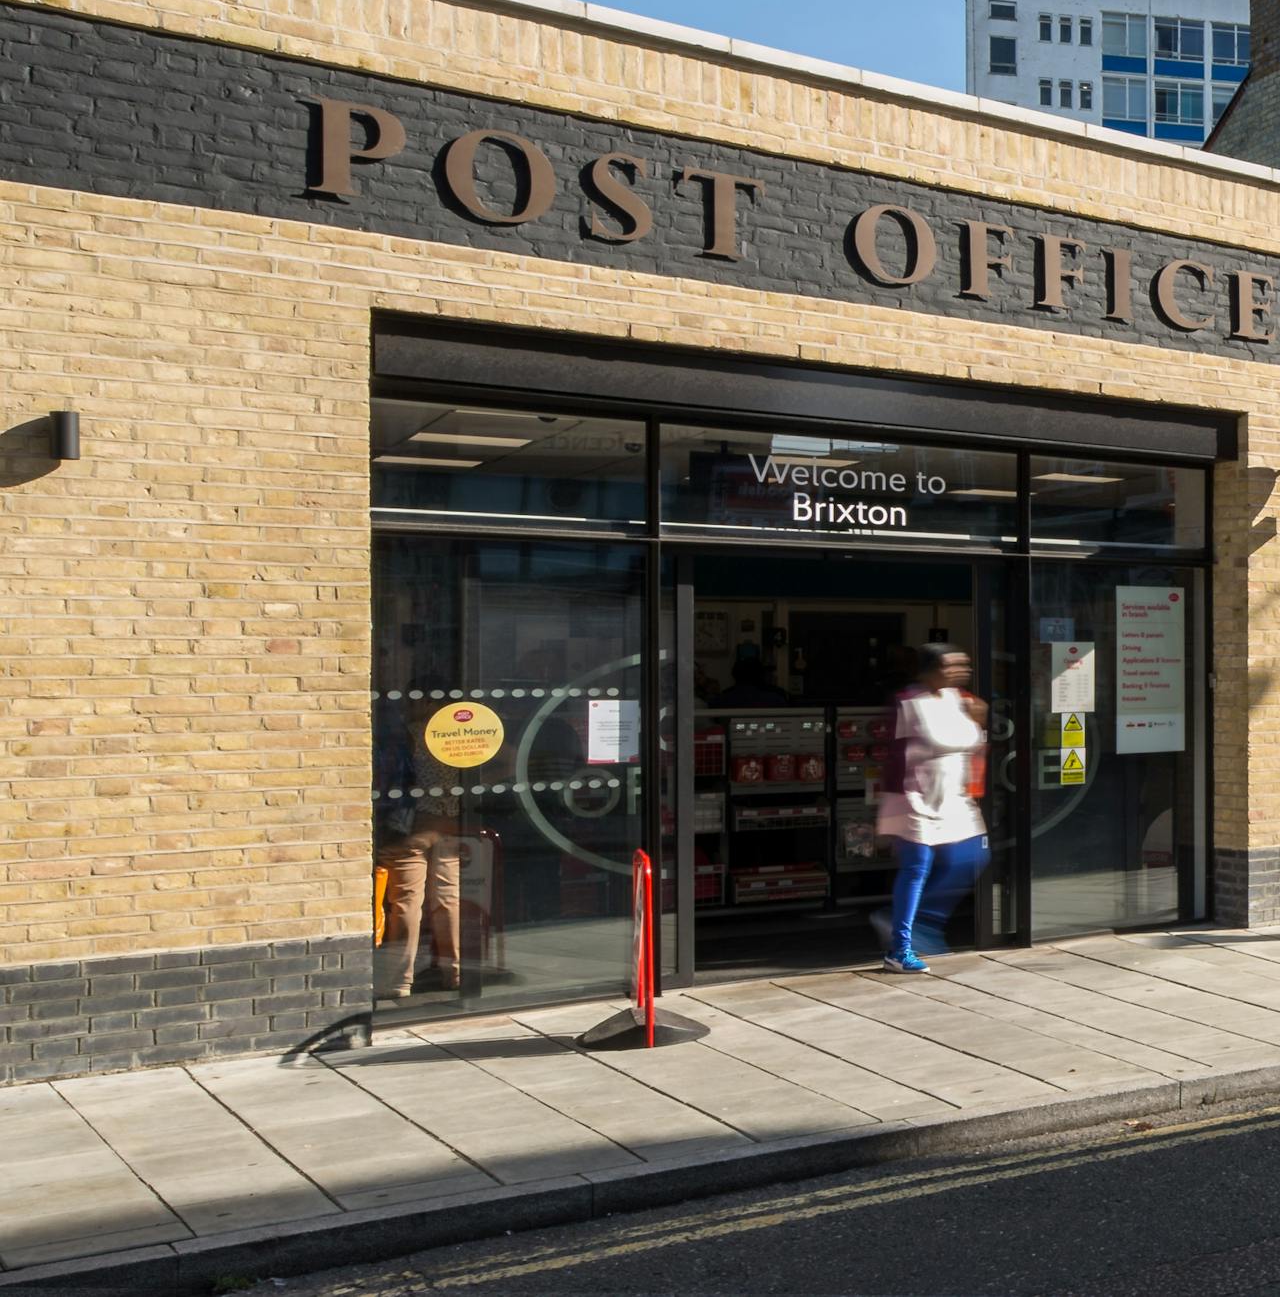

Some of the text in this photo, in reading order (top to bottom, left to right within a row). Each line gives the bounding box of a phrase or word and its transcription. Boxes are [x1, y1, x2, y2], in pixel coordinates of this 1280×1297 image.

[309, 96, 1278, 343] POST OFFICE
[748, 453, 907, 492] Welcome
[916, 470, 947, 496] to
[792, 491, 908, 527] Brixton
[431, 727, 498, 739] Travel Money
